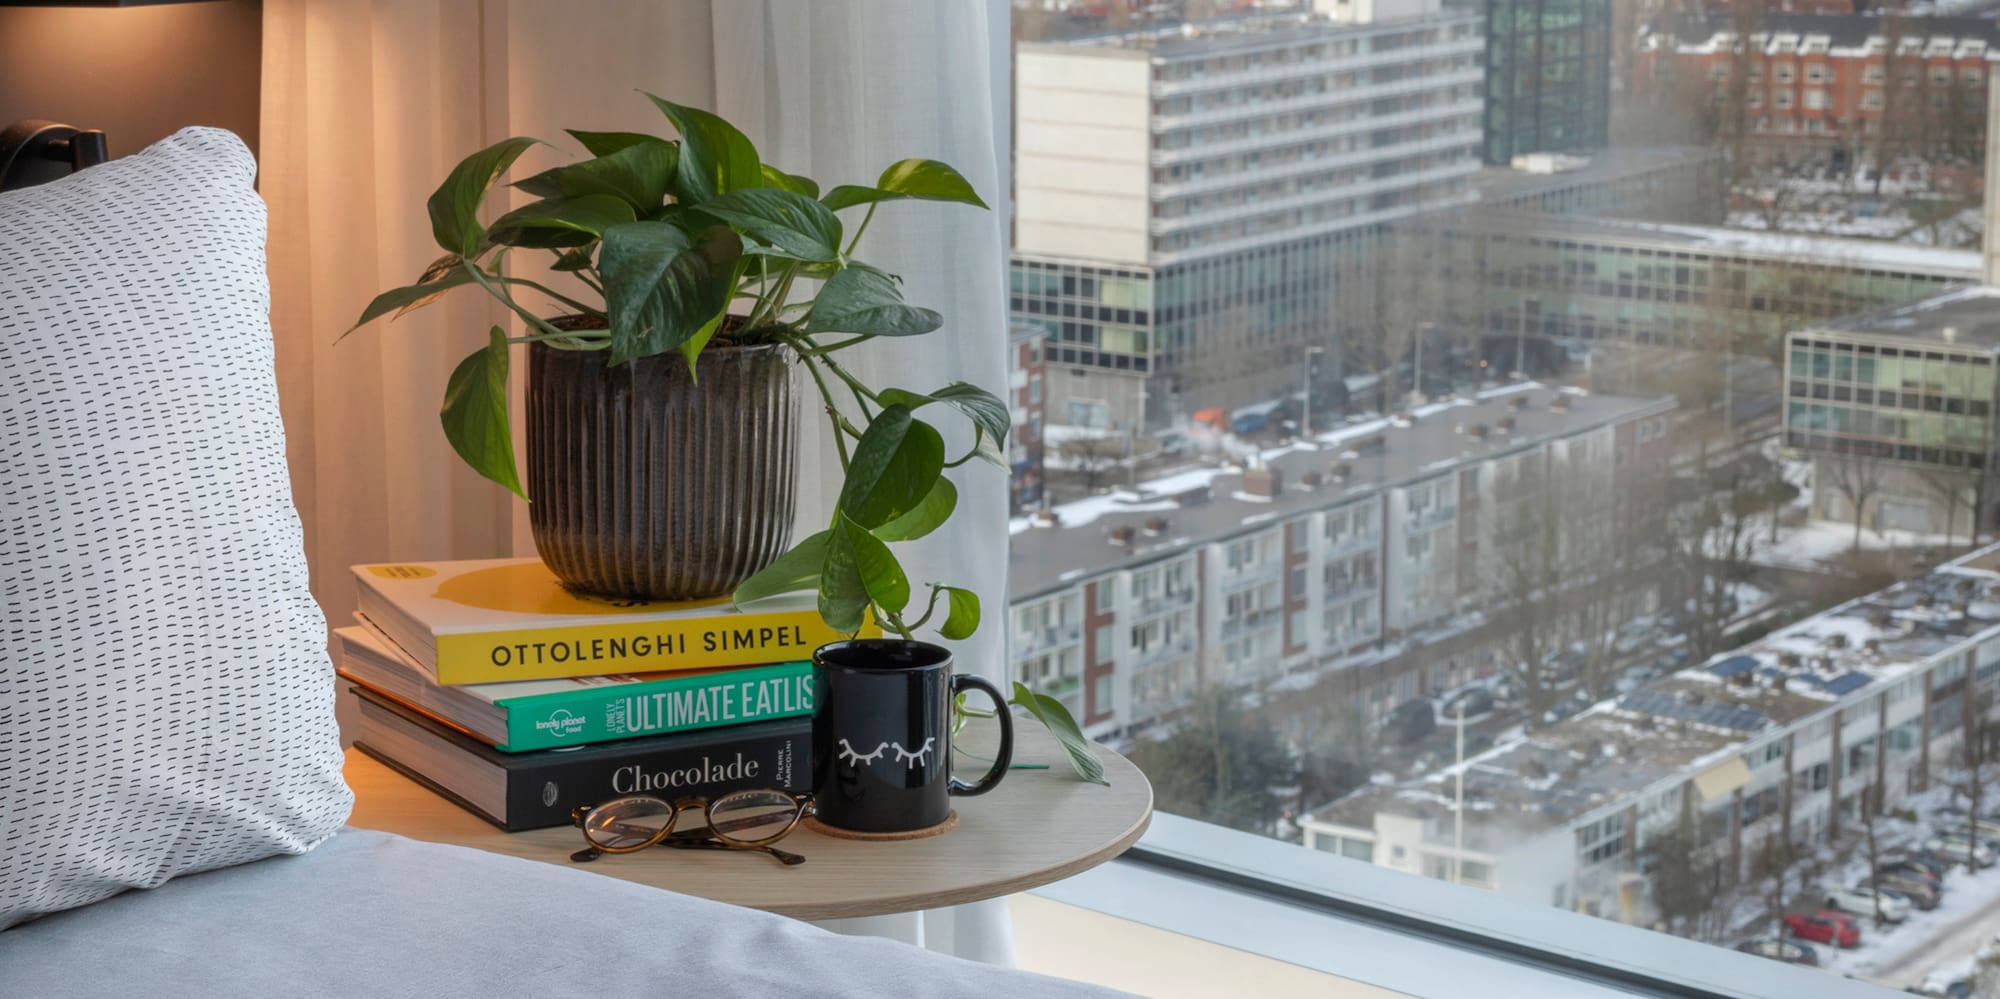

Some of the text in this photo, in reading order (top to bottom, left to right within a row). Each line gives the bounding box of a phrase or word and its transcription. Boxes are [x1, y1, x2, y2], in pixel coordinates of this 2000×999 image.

[491, 625, 806, 666] OTTOLENGHI SIMPEL
[536, 716, 586, 730] lonely planet
[606, 703, 616, 732] LONELY
[616, 698, 625, 733] PLANETS
[626, 684, 735, 732] ULTIMATE
[565, 725, 582, 733] food
[612, 753, 759, 794] Chocolade
[776, 748, 785, 781] PIERRE
[784, 740, 792, 788] MARCOLINI
